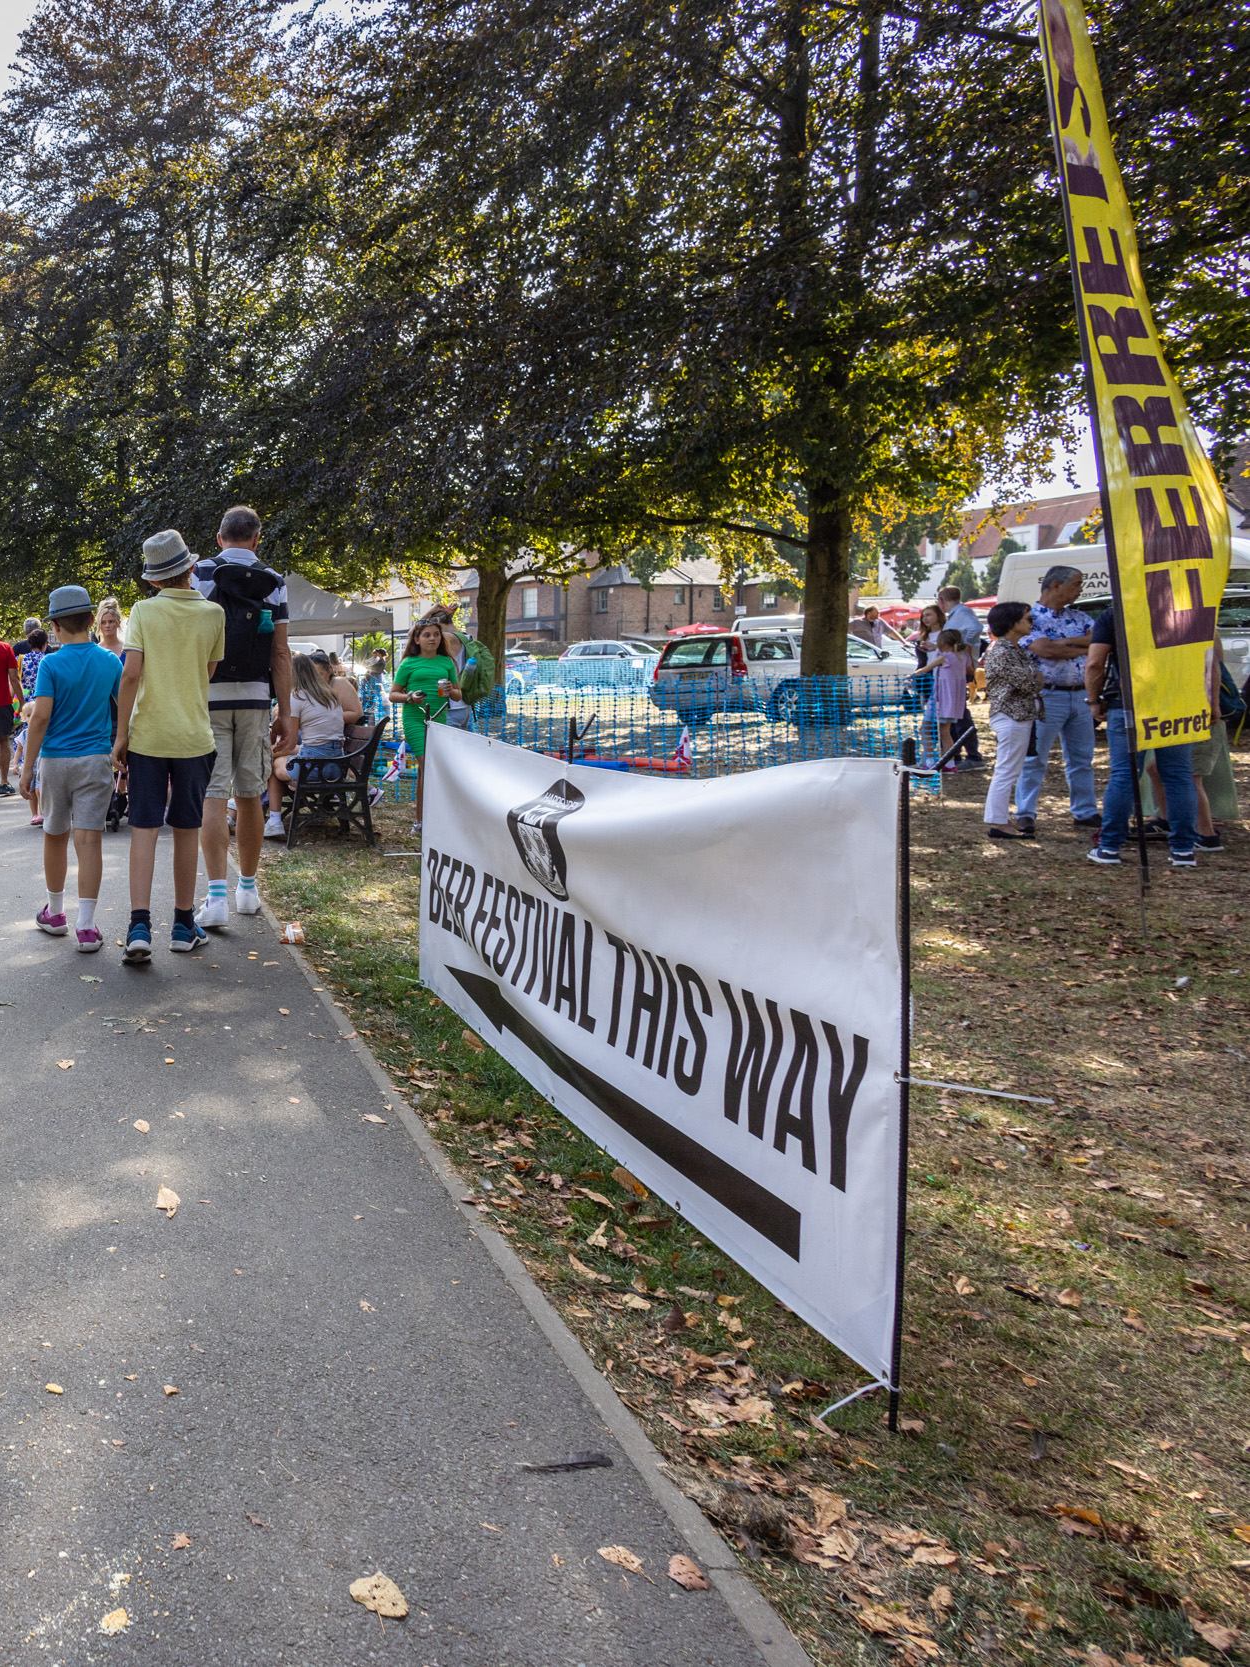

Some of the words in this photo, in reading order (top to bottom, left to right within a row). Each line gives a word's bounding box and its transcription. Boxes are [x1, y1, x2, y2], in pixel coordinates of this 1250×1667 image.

[427, 847, 476, 945] BEER
[470, 872, 597, 1035] FESTIVAL
[604, 930, 713, 1097] THIS
[718, 979, 869, 1194] WAY
